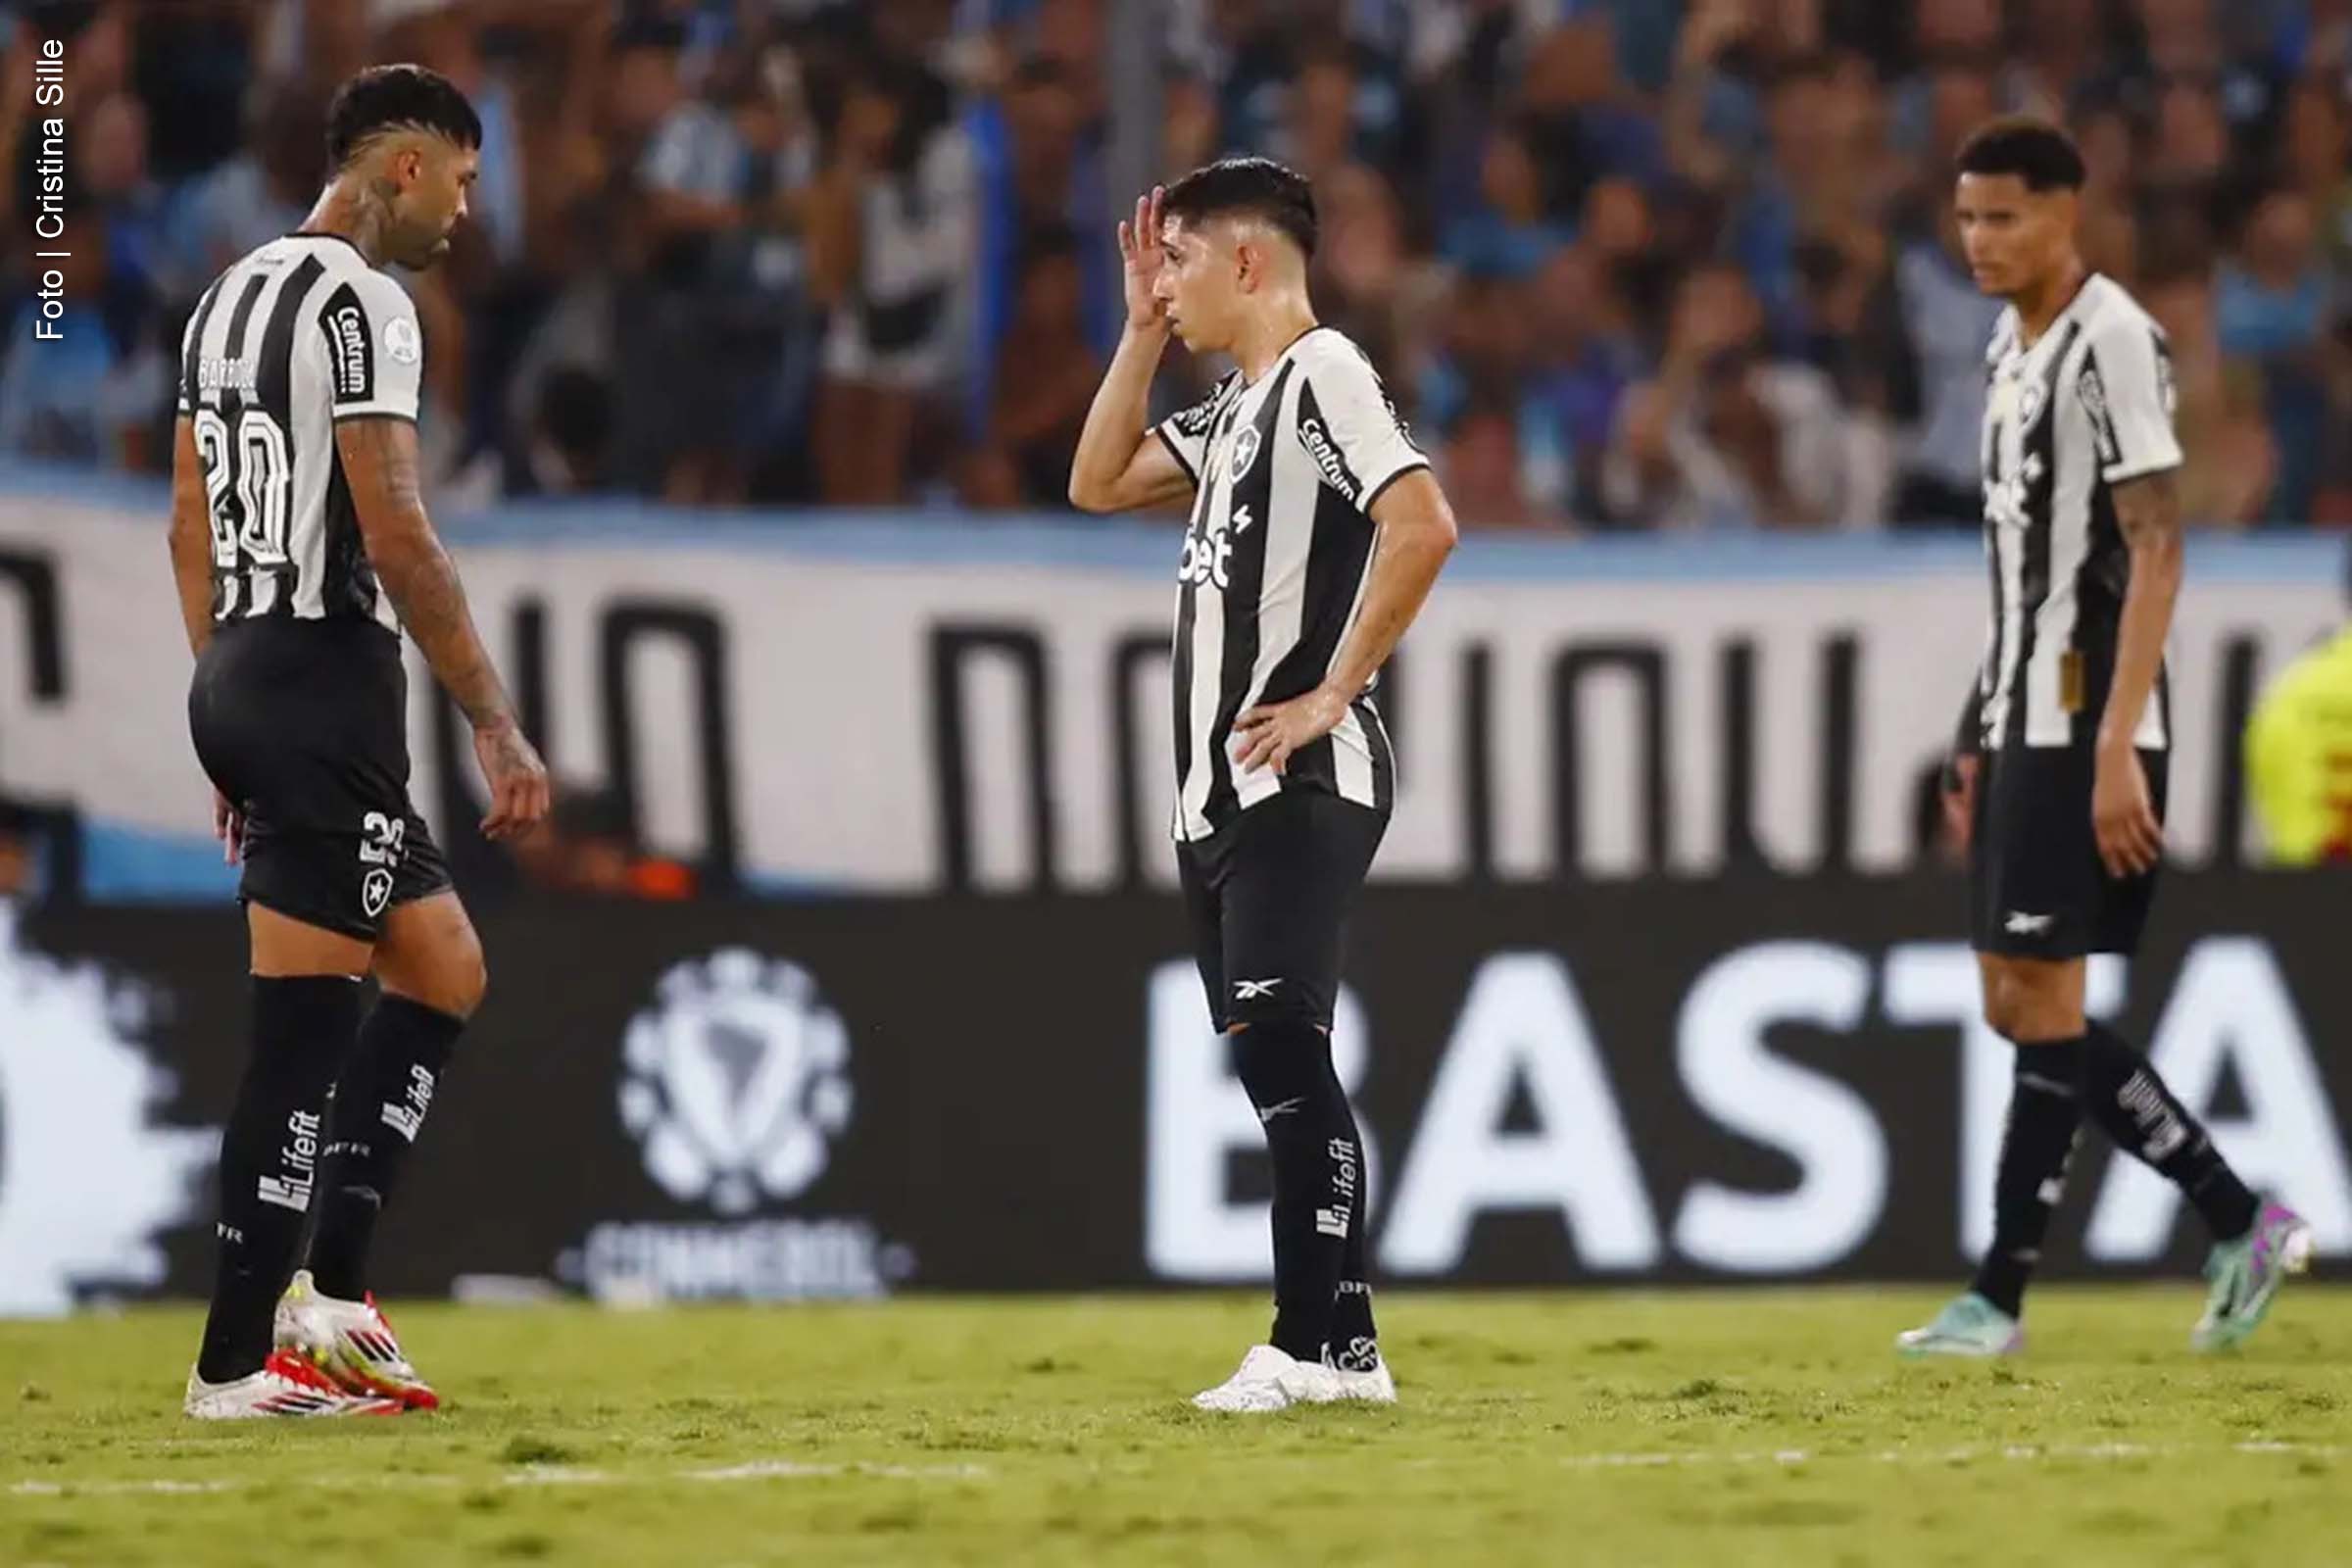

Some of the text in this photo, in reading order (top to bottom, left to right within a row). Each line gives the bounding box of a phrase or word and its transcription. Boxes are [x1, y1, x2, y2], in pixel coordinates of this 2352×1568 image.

[337, 307, 366, 393] Centrum
[194, 410, 290, 567] 20
[1302, 418, 1355, 501] Centrum
[1145, 933, 2352, 1281] BASTA
